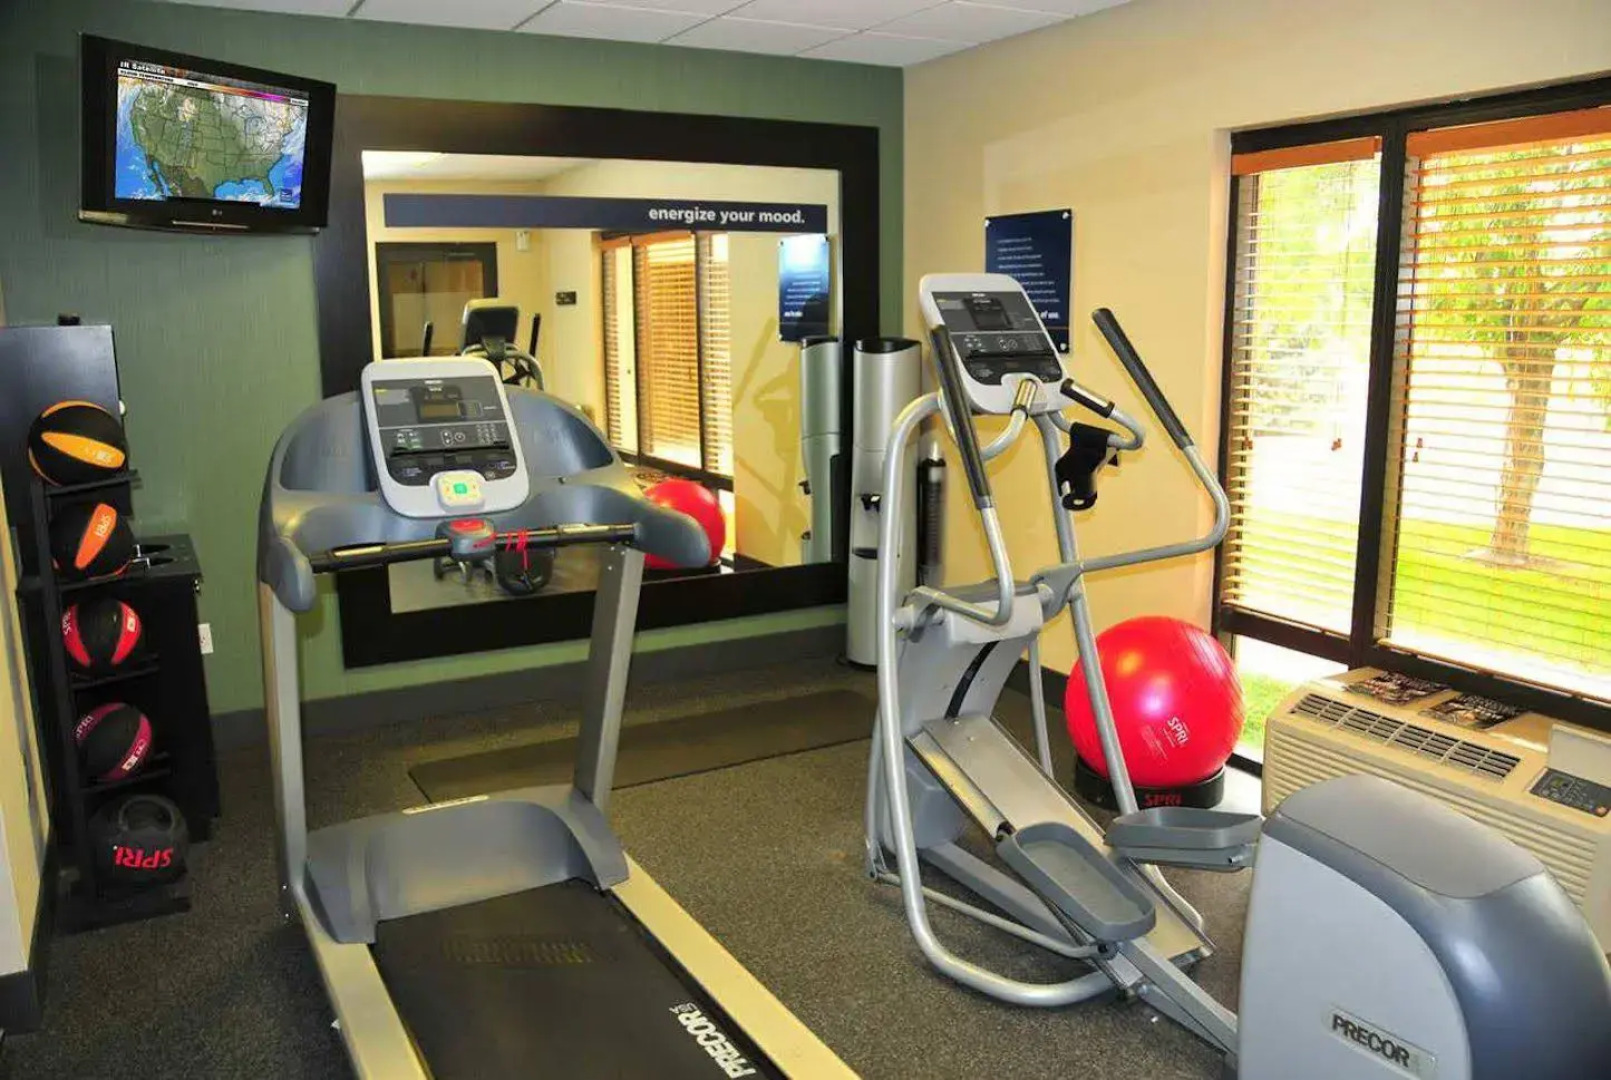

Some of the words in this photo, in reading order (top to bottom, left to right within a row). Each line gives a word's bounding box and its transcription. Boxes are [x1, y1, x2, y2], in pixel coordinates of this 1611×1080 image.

[649, 206, 716, 224] energize
[720, 211, 755, 225] your
[758, 209, 806, 224] mood.
[1167, 716, 1189, 746] SPRI
[115, 846, 174, 868] SPRI
[678, 1009, 757, 1079] PRECOR
[1332, 1013, 1410, 1068] PRECOR
